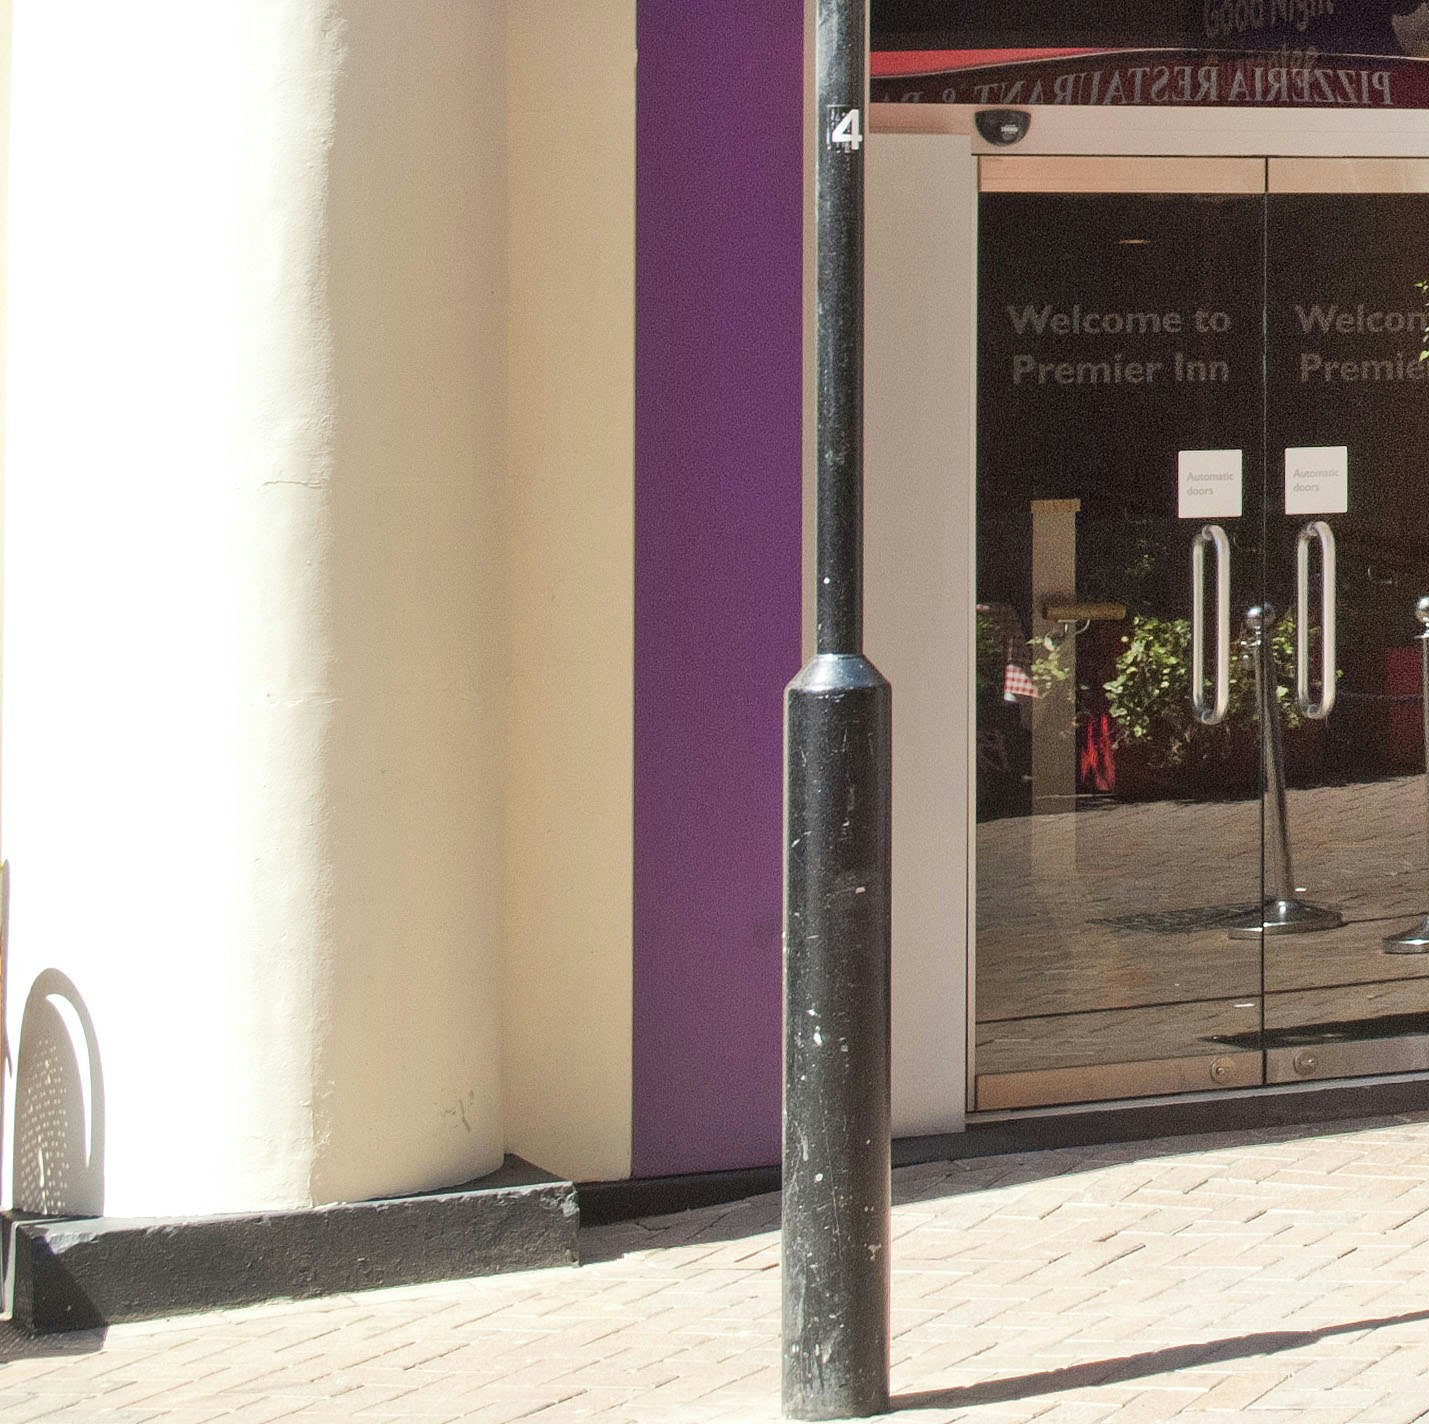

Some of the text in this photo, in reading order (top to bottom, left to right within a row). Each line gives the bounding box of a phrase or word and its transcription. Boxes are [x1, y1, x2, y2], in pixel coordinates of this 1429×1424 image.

[832, 109, 863, 150] 4
[1007, 303, 1232, 335] Welcome to
[1012, 352, 1230, 385] Premier Inn
[1186, 471, 1234, 482] Automatic
[1293, 468, 1340, 479] Automatic
[1186, 486, 1214, 496] doors
[1293, 483, 1320, 493] doors
